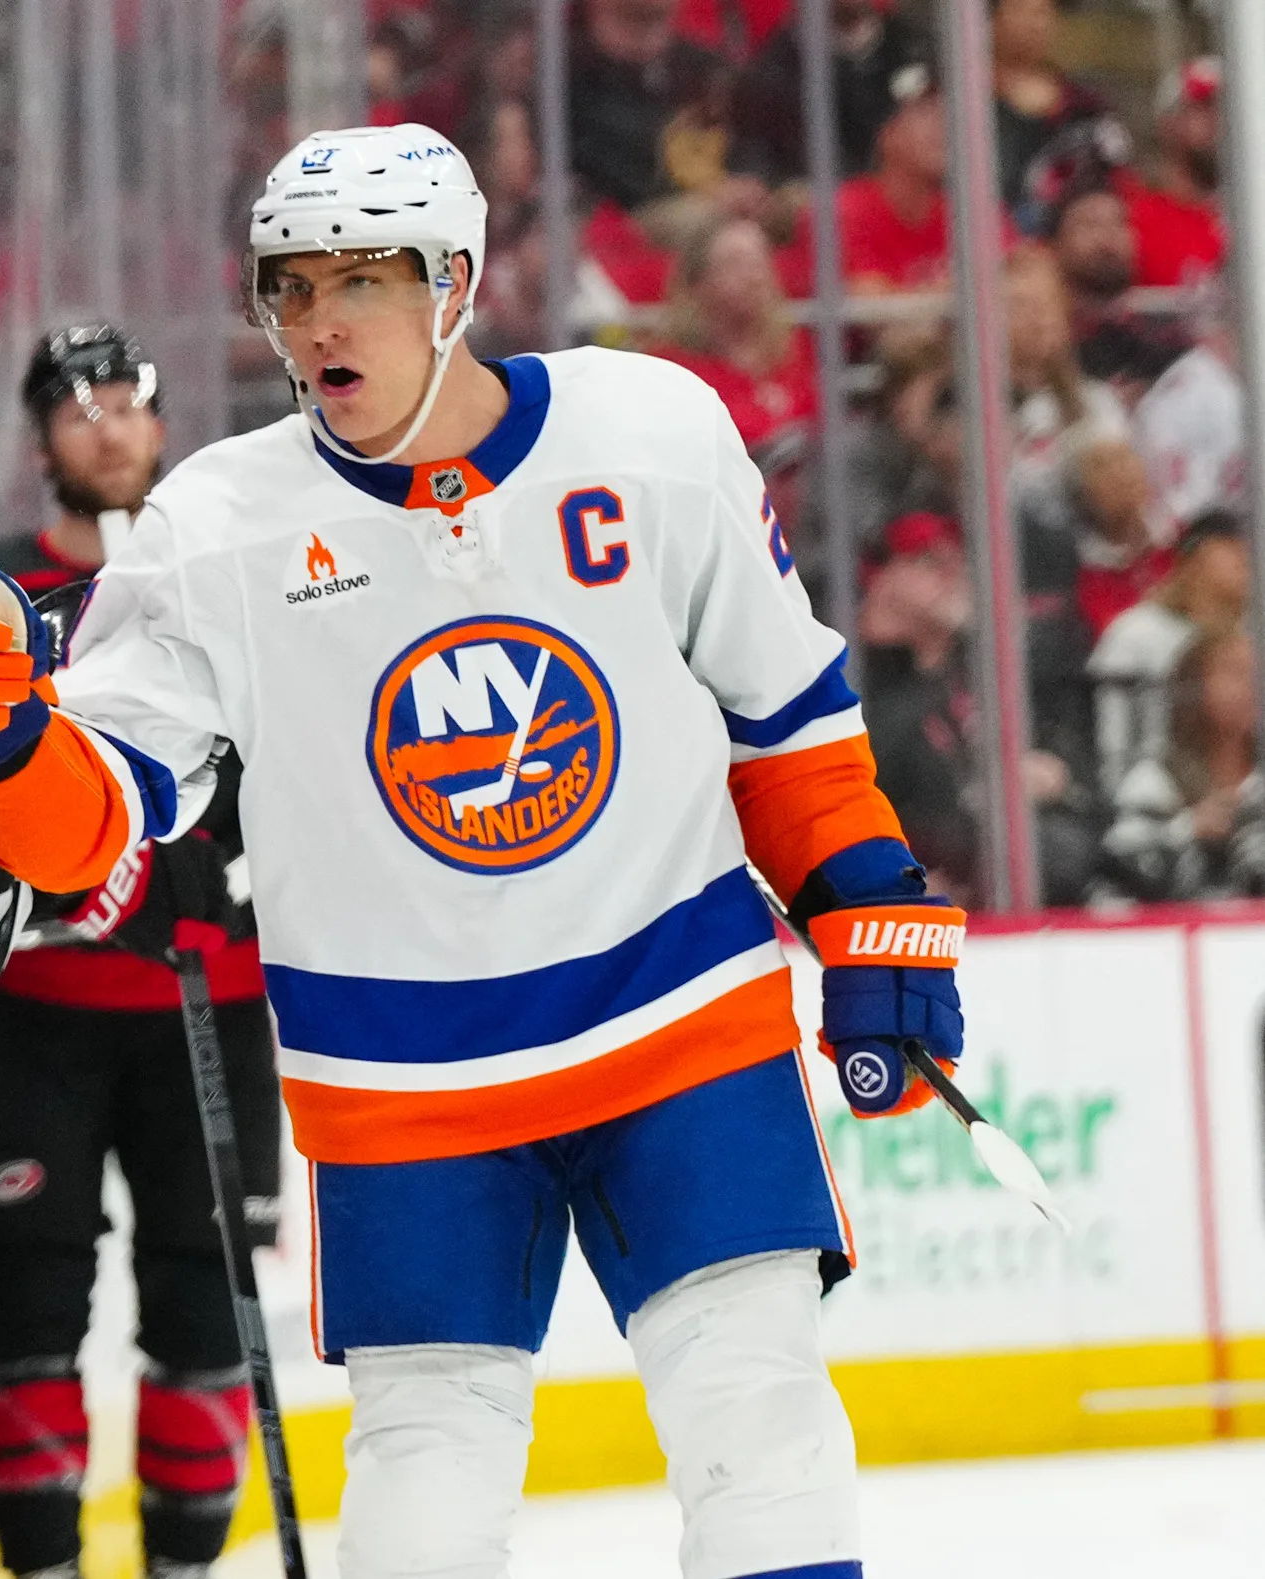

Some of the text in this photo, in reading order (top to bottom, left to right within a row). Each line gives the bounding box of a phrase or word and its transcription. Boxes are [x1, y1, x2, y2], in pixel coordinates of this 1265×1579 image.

[397, 146, 456, 161] VIAM
[557, 485, 631, 588] C
[286, 573, 371, 604] solo stove
[410, 642, 551, 738] NY
[406, 746, 591, 846] ISLANDERS
